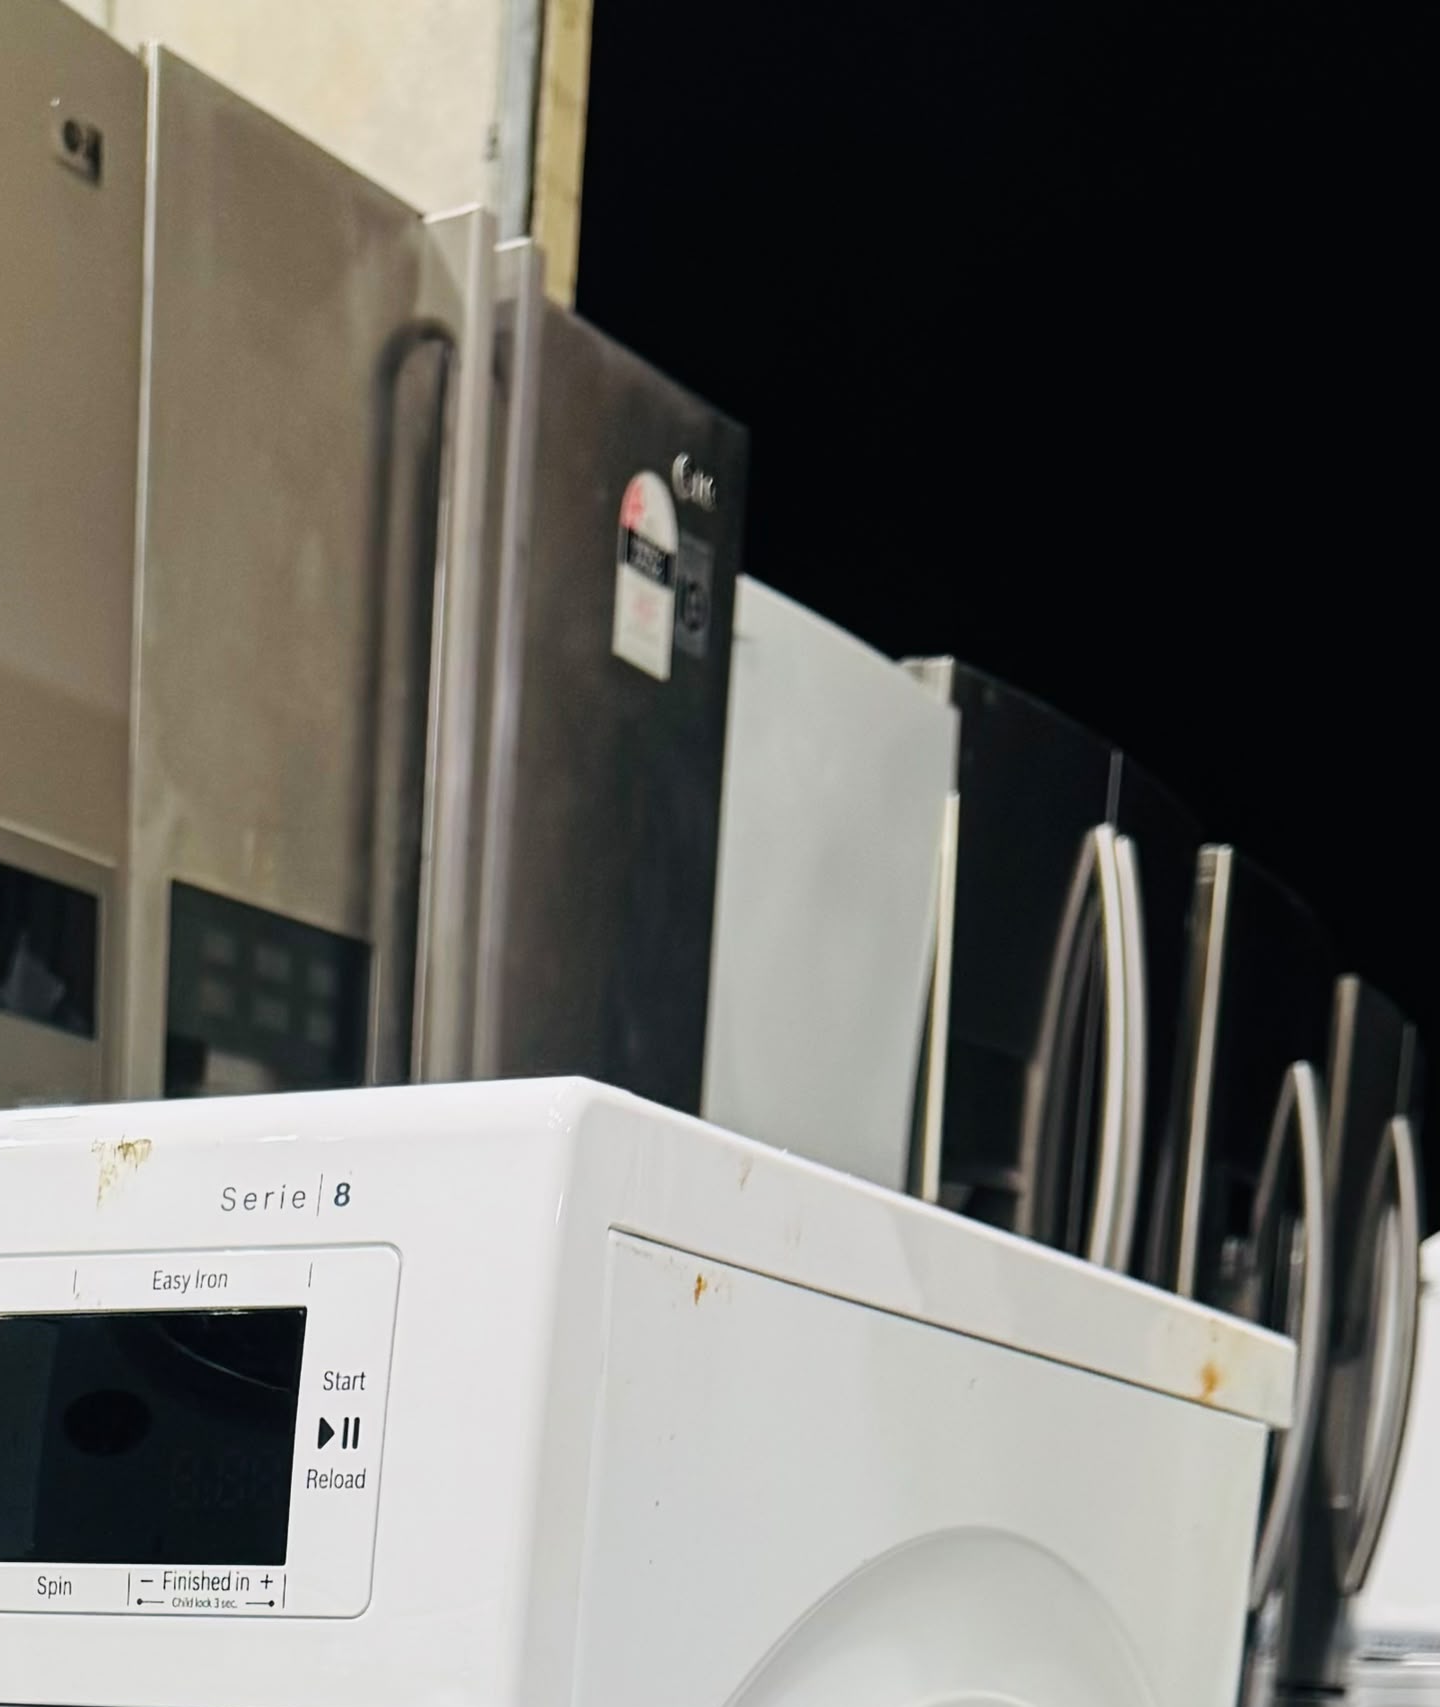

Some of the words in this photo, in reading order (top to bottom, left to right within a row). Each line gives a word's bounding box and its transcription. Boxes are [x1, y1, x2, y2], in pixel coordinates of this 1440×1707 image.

[220, 1184, 306, 1212] Serie
[333, 1182, 351, 1208] 8
[152, 1270, 190, 1294] Easy
[195, 1268, 229, 1290] Iron
[322, 1370, 365, 1391] Start
[306, 1468, 367, 1489] Reload
[37, 1575, 72, 1599] Spin
[162, 1570, 230, 1592] Finished
[235, 1571, 250, 1592] in
